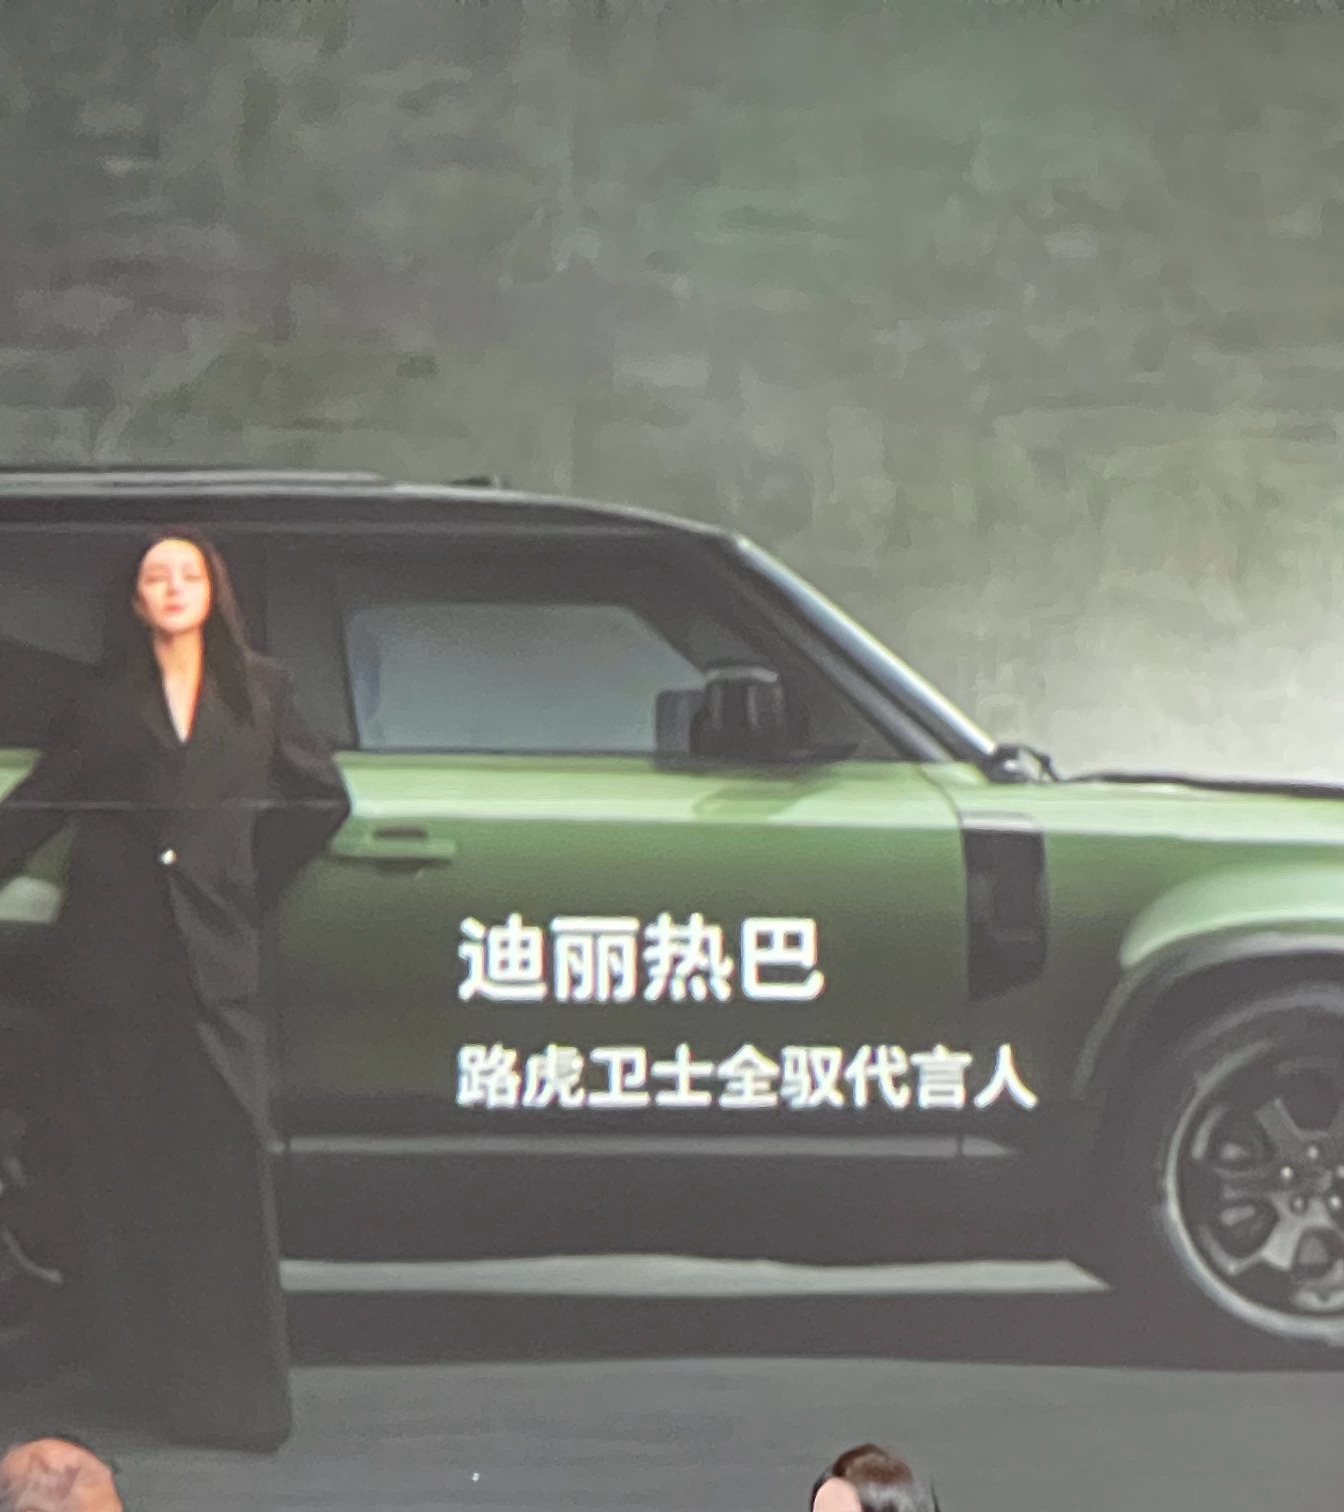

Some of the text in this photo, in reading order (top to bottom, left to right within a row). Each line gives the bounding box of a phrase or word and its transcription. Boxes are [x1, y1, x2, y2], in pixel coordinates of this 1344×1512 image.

[458, 912, 825, 1002] 迪丽热巴
[457, 1042, 1039, 1110] 路虎卫士全驭代言人
